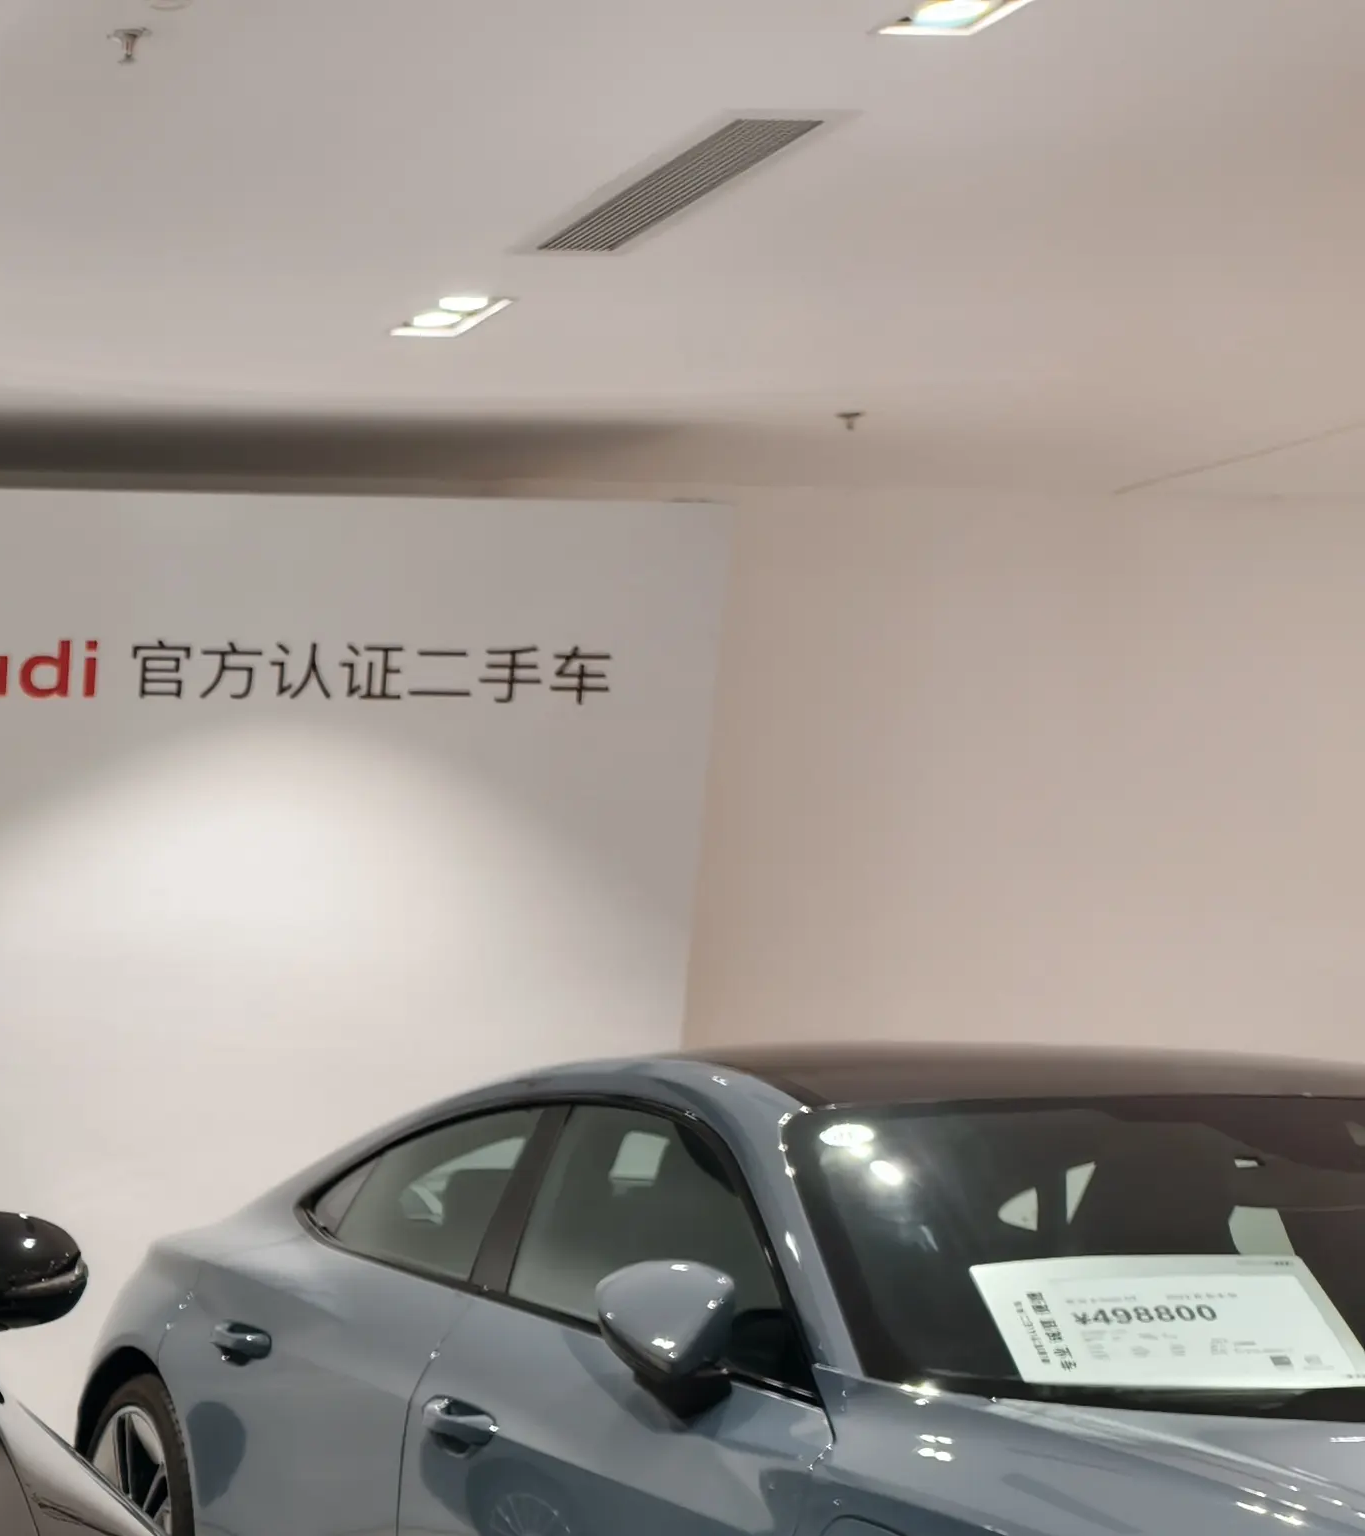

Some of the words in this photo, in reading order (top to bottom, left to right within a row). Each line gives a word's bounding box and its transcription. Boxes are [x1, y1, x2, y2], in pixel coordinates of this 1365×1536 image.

[131, 638, 613, 706] 官方认证二手车
[1072, 1303, 1219, 1326] ¥498800
